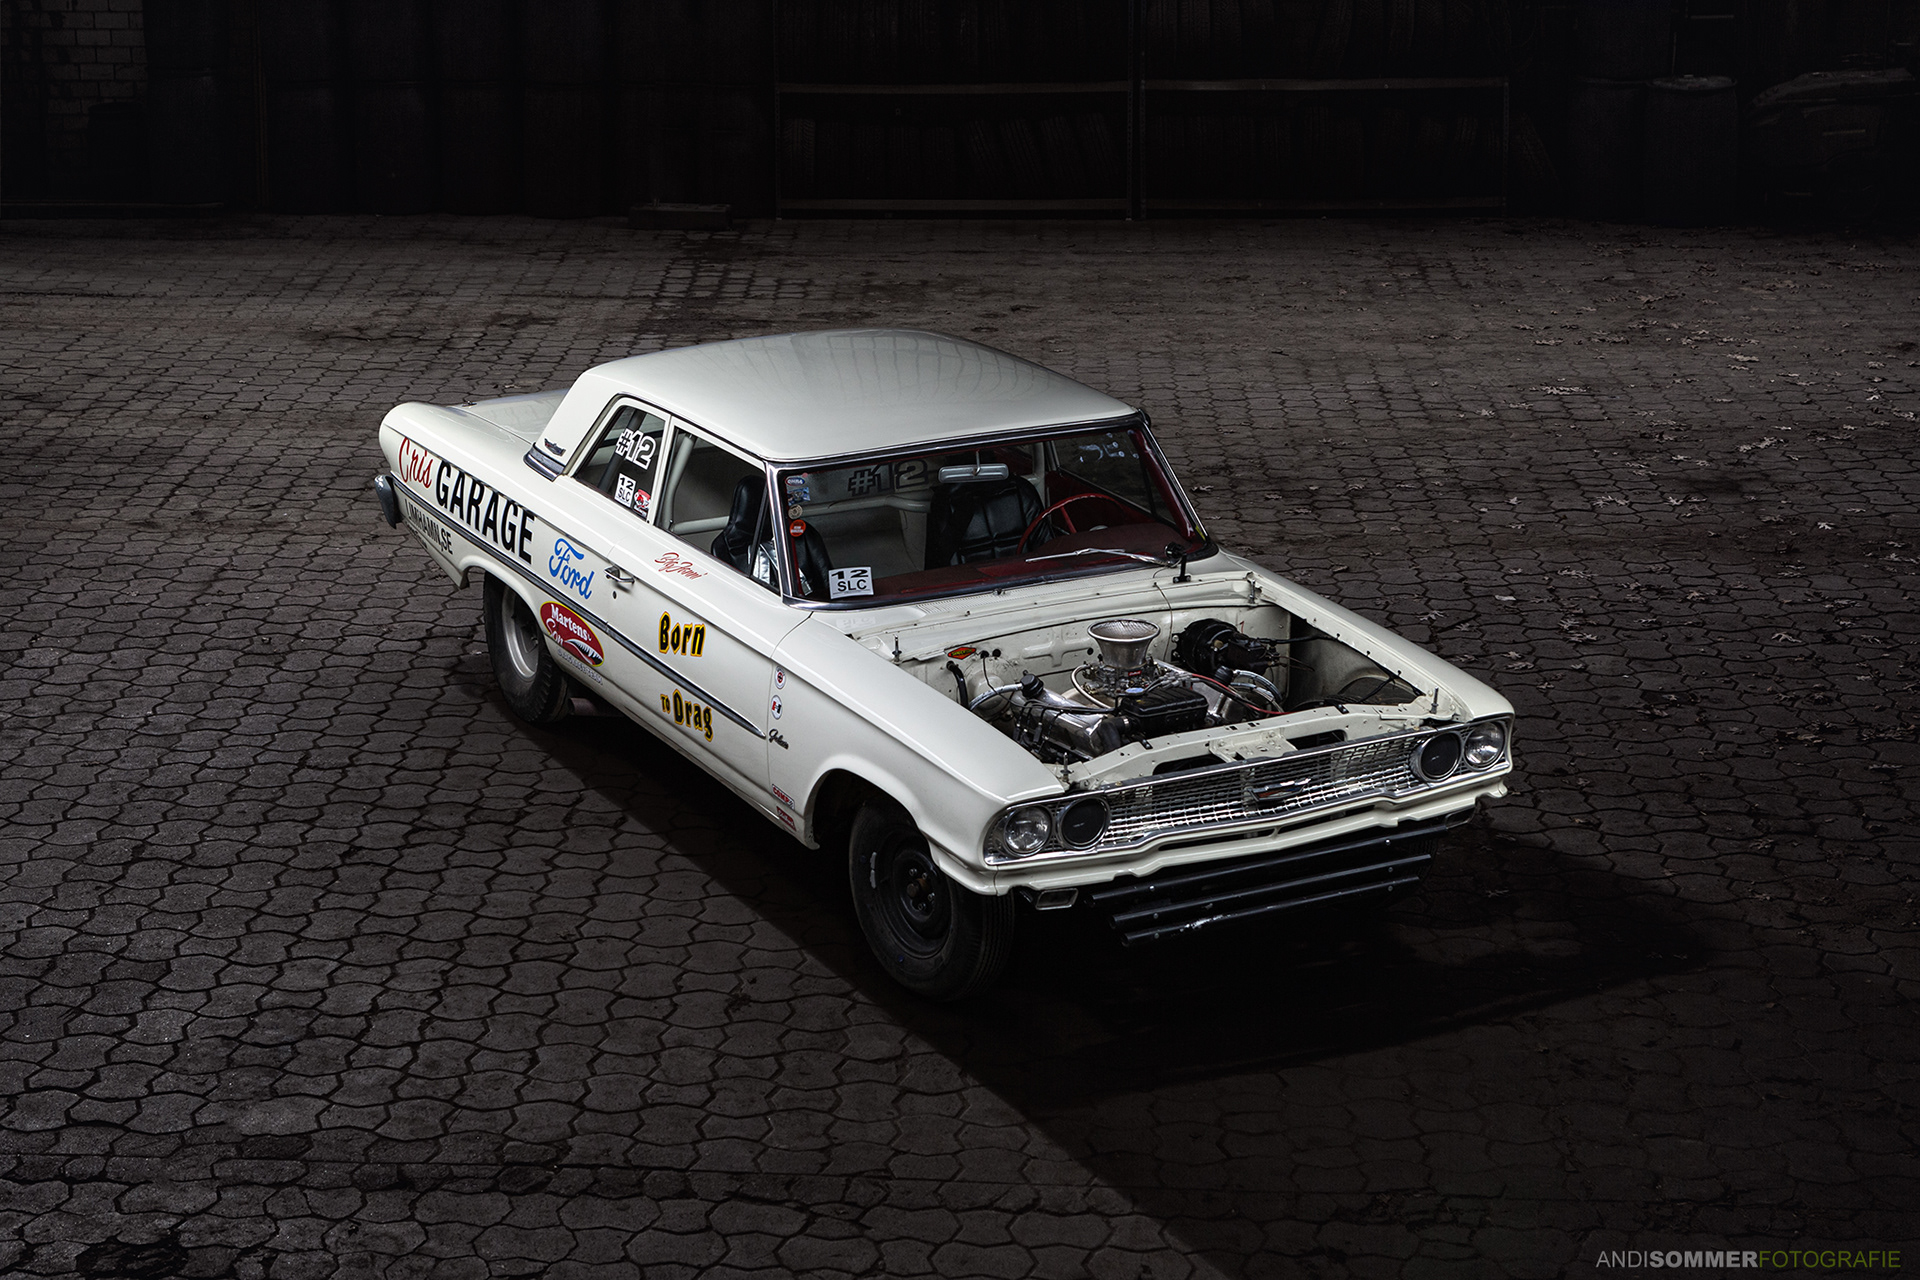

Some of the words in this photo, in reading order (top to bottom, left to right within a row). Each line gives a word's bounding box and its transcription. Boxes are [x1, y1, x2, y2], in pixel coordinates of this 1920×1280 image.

[615, 428, 657, 470] #12
[617, 487, 631, 502] SLC
[619, 477, 634, 491] 12
[847, 458, 929, 497] #12
[399, 436, 434, 488] Cris
[435, 460, 536, 565] GARAGE
[549, 538, 595, 600] Ford
[831, 569, 869, 579] 12
[837, 579, 867, 592] SLC
[659, 611, 706, 657] Born
[672, 688, 714, 742] Drag
